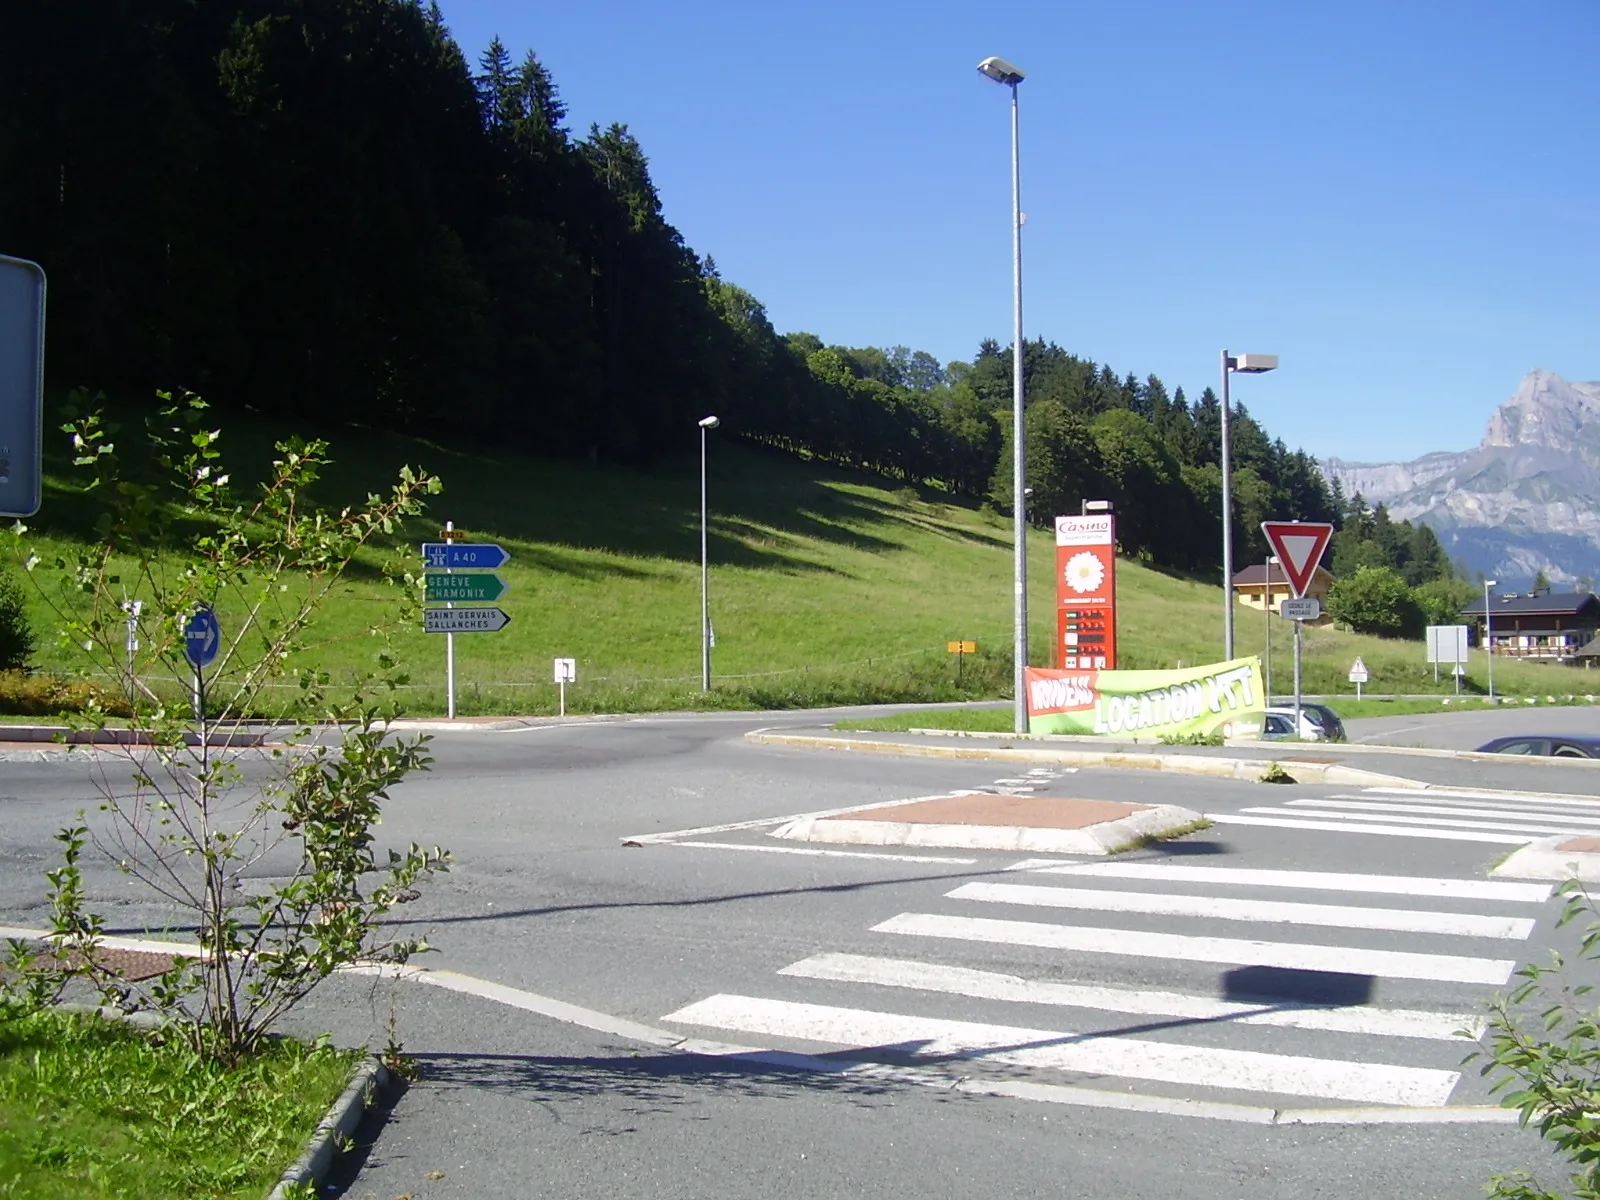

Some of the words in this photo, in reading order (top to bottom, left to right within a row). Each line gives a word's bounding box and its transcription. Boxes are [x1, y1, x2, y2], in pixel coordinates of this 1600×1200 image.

[1059, 521, 1108, 533] Casino
[453, 552, 460, 562] A
[462, 552, 477, 562] 40
[428, 611, 454, 620] SAINT
[458, 611, 497, 620] GERVAIS
[428, 621, 489, 629] SALLANCHES
[1093, 679, 1203, 734] LOCATION
[1202, 665, 1253, 714] VTT
